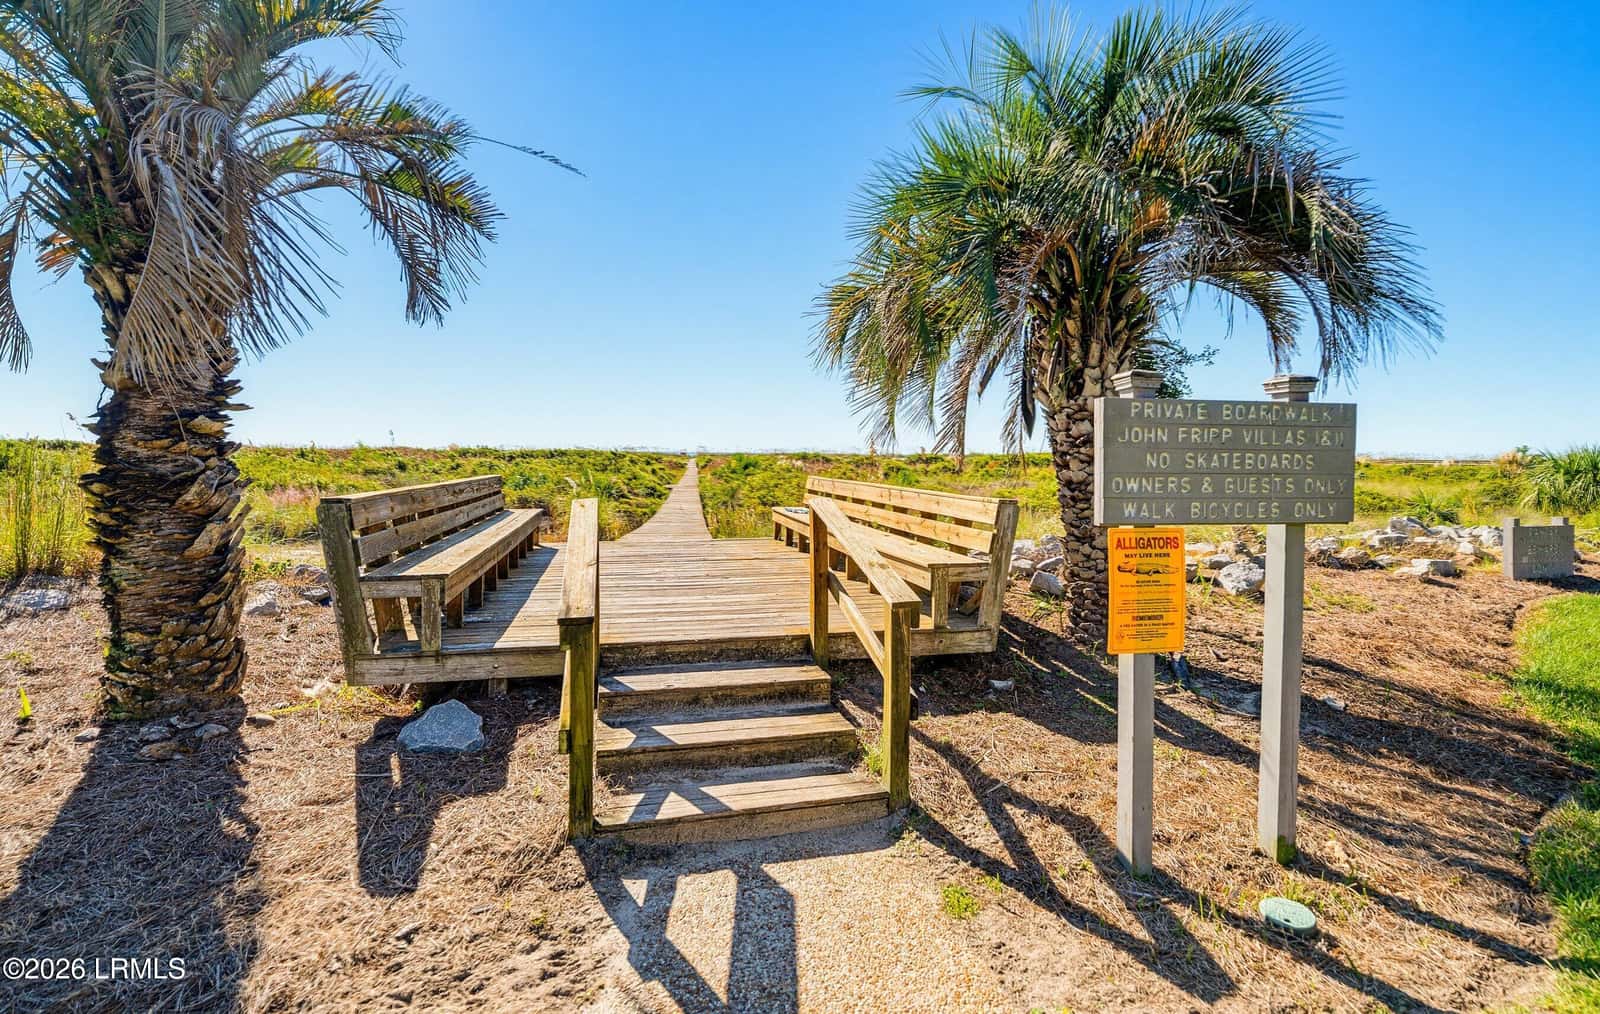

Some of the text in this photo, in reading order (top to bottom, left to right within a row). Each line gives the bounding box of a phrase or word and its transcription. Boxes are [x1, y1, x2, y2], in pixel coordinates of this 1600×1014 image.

[1130, 402, 1333, 421] PRIVATE BOARDWALK
[1118, 427, 1168, 443] JOHN
[1178, 427, 1232, 444] FRIPP
[1243, 430, 1304, 445] VILLAS
[1146, 452, 1314, 469] NO SKATEBOARDS
[1112, 477, 1346, 494] OWNERS & GUESTS ONLY
[1123, 503, 1336, 519] WALK BICYCLES ONLY
[1116, 537, 1179, 549] ALLIGATORS
